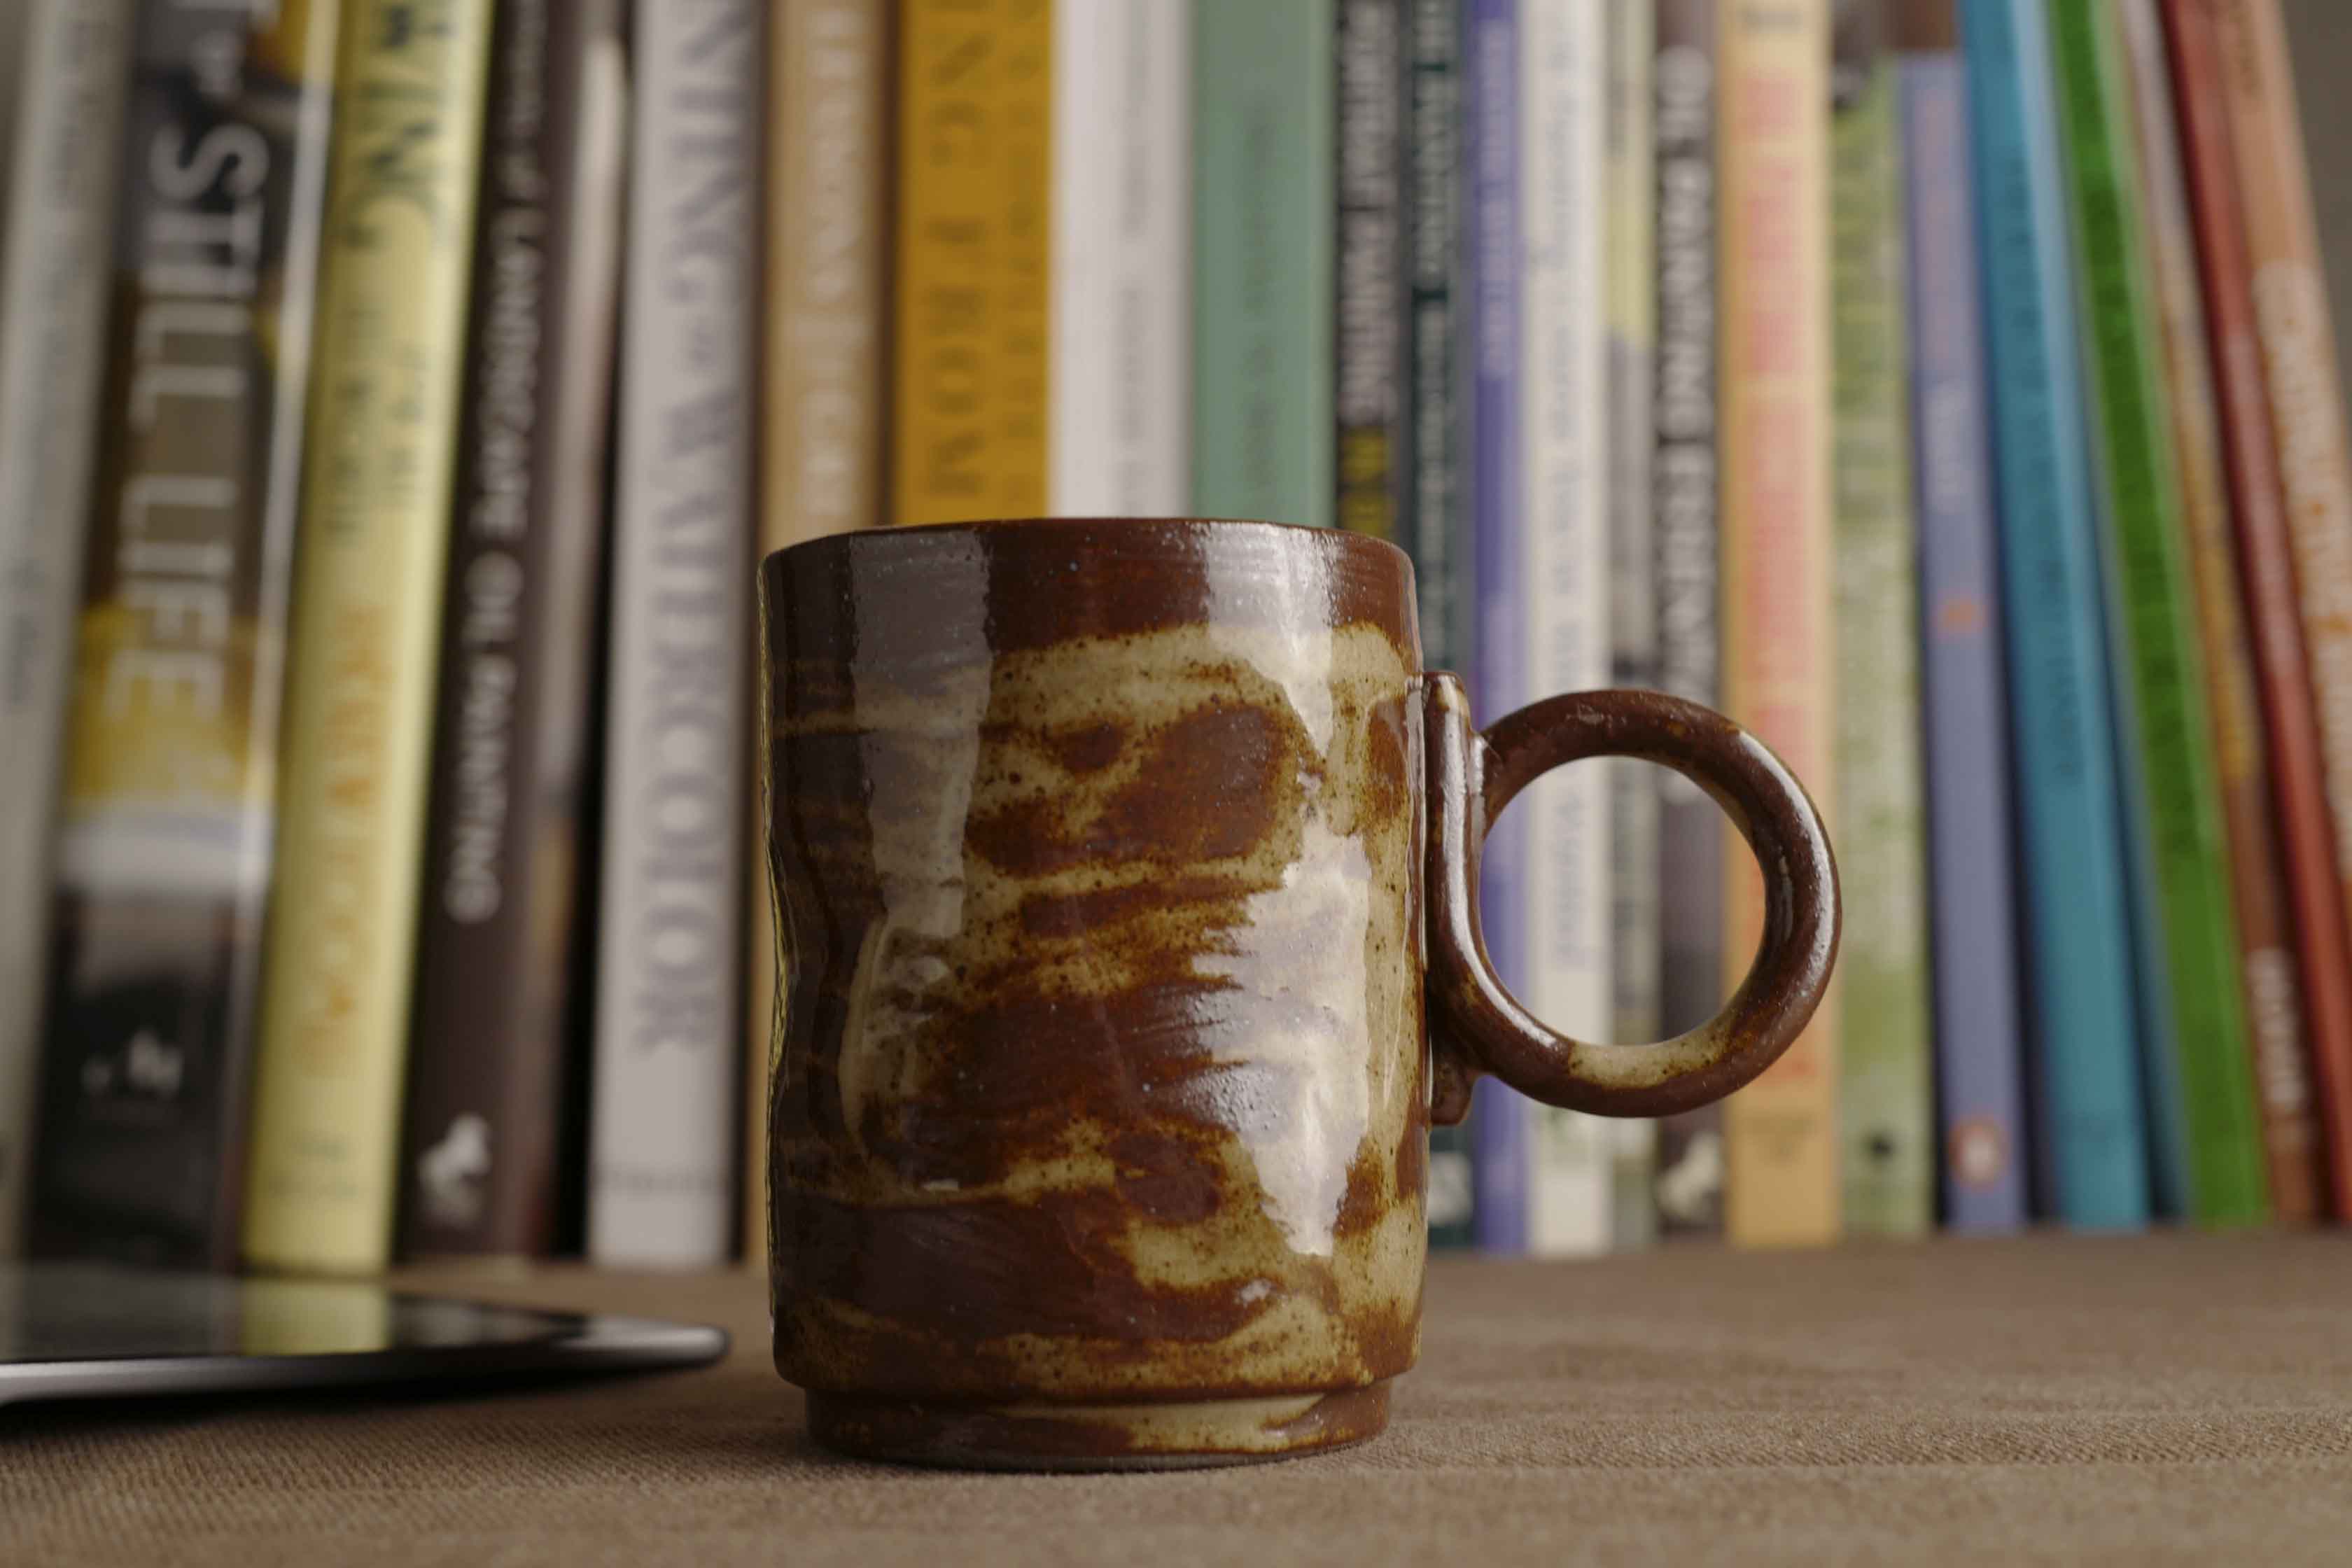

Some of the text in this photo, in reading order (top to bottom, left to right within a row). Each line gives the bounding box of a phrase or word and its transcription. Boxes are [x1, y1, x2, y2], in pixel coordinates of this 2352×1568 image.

[132, 122, 272, 430] STILL
[466, 209, 548, 538] LANDSCAPE
[925, 218, 985, 498] FROM
[1659, 157, 1713, 438] PAINTING
[104, 477, 237, 724] LIFE
[458, 551, 524, 645] OIL
[631, 389, 743, 1058] WATERCOLOR
[444, 656, 518, 924] PAINTING
